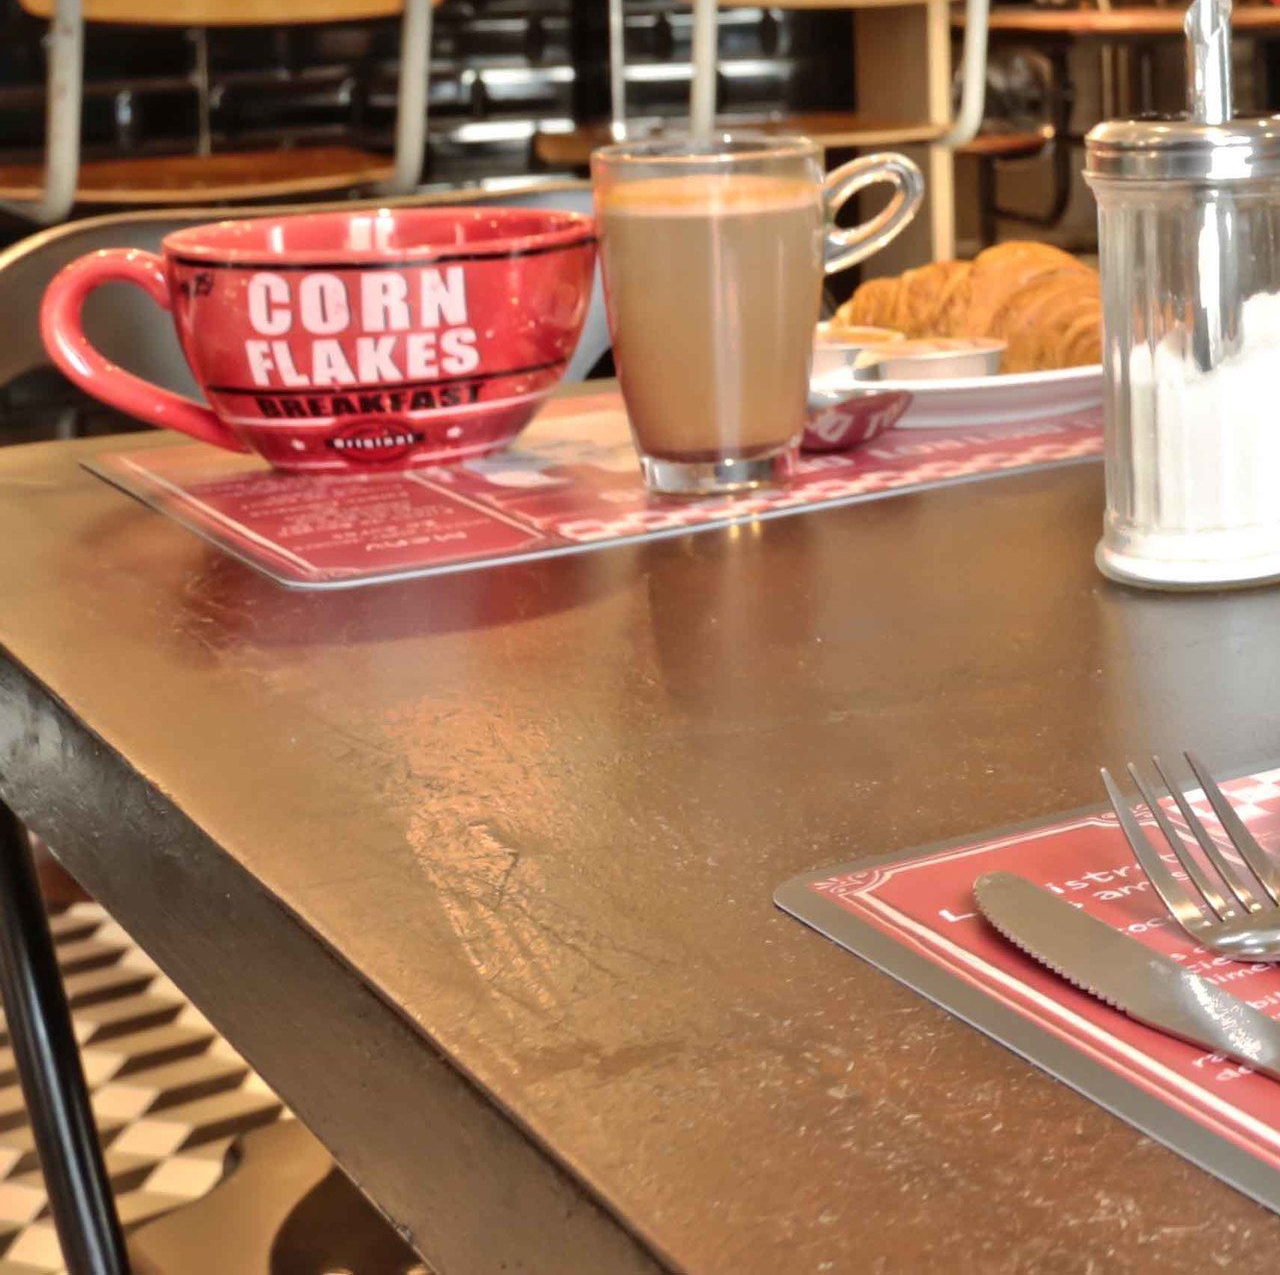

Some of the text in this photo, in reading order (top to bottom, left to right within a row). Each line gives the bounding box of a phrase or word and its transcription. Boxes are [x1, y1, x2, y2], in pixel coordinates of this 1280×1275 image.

[247, 266, 469, 336] CORN
[244, 326, 481, 387] FLAKES
[256, 385, 481, 418] BREAKFAST
